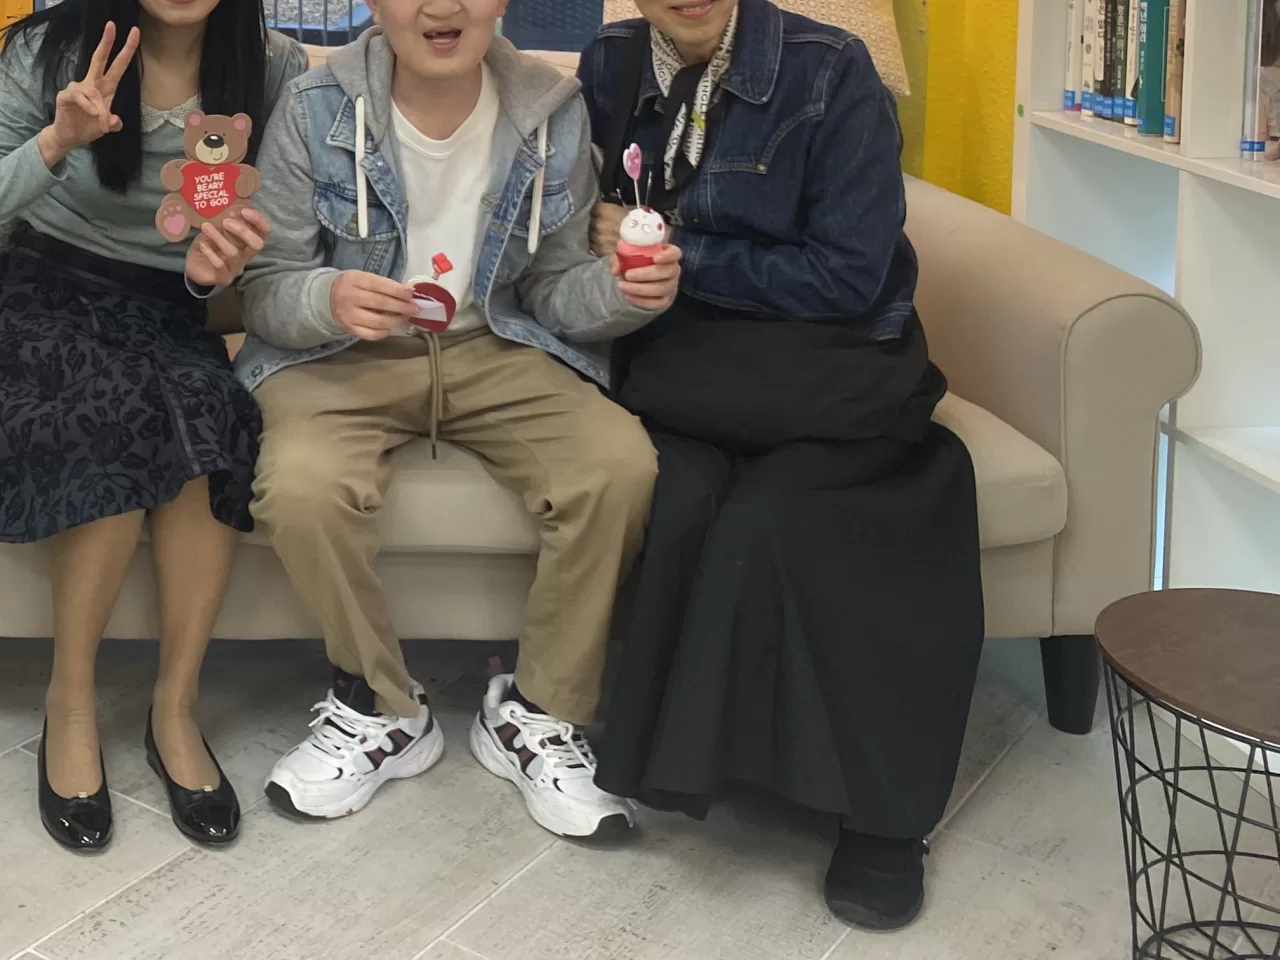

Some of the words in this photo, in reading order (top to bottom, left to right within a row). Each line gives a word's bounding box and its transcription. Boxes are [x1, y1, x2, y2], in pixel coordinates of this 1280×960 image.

[194, 172, 225, 184] YOU'RE
[197, 181, 224, 192] BEARY
[193, 189, 230, 201] SPECIAL
[194, 200, 207, 210] TO
[210, 197, 229, 207] GOD
